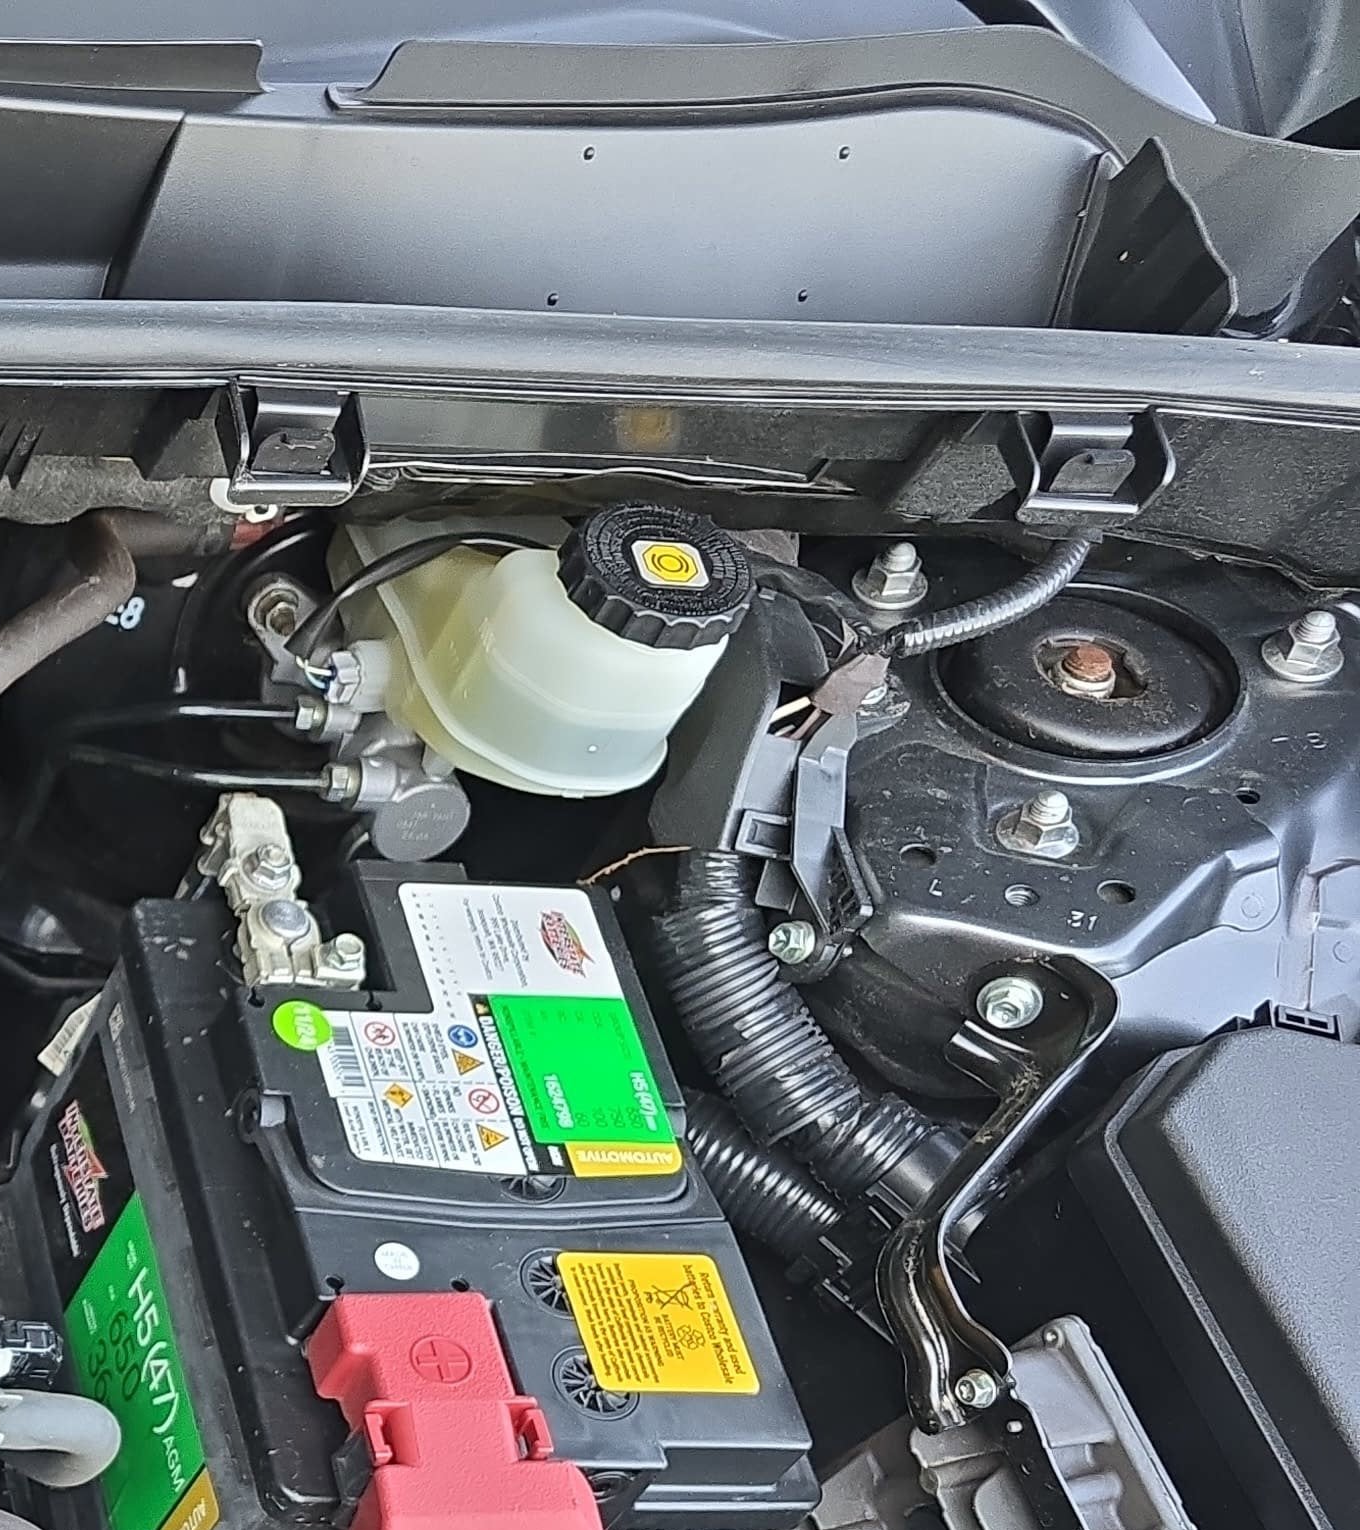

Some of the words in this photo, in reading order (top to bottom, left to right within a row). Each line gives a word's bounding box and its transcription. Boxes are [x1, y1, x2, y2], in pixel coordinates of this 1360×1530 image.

[540, 911, 571, 971] BATTERIES
[550, 910, 586, 978] INTERSTATE
[480, 1015, 521, 1116] DANGER/POISON
[629, 1071, 648, 1091] H5
[57, 1115, 93, 1233] BATTERIES
[65, 1099, 106, 1230] INTERSTATE
[572, 1147, 676, 1165] AUTOMOTIVE
[128, 1266, 161, 1349] H5
[107, 1307, 142, 1401] 650
[700, 1311, 718, 1340] Costco
[711, 1341, 734, 1384] Wholesale
[142, 1341, 180, 1434] (47)
[161, 1435, 186, 1493] AGM
